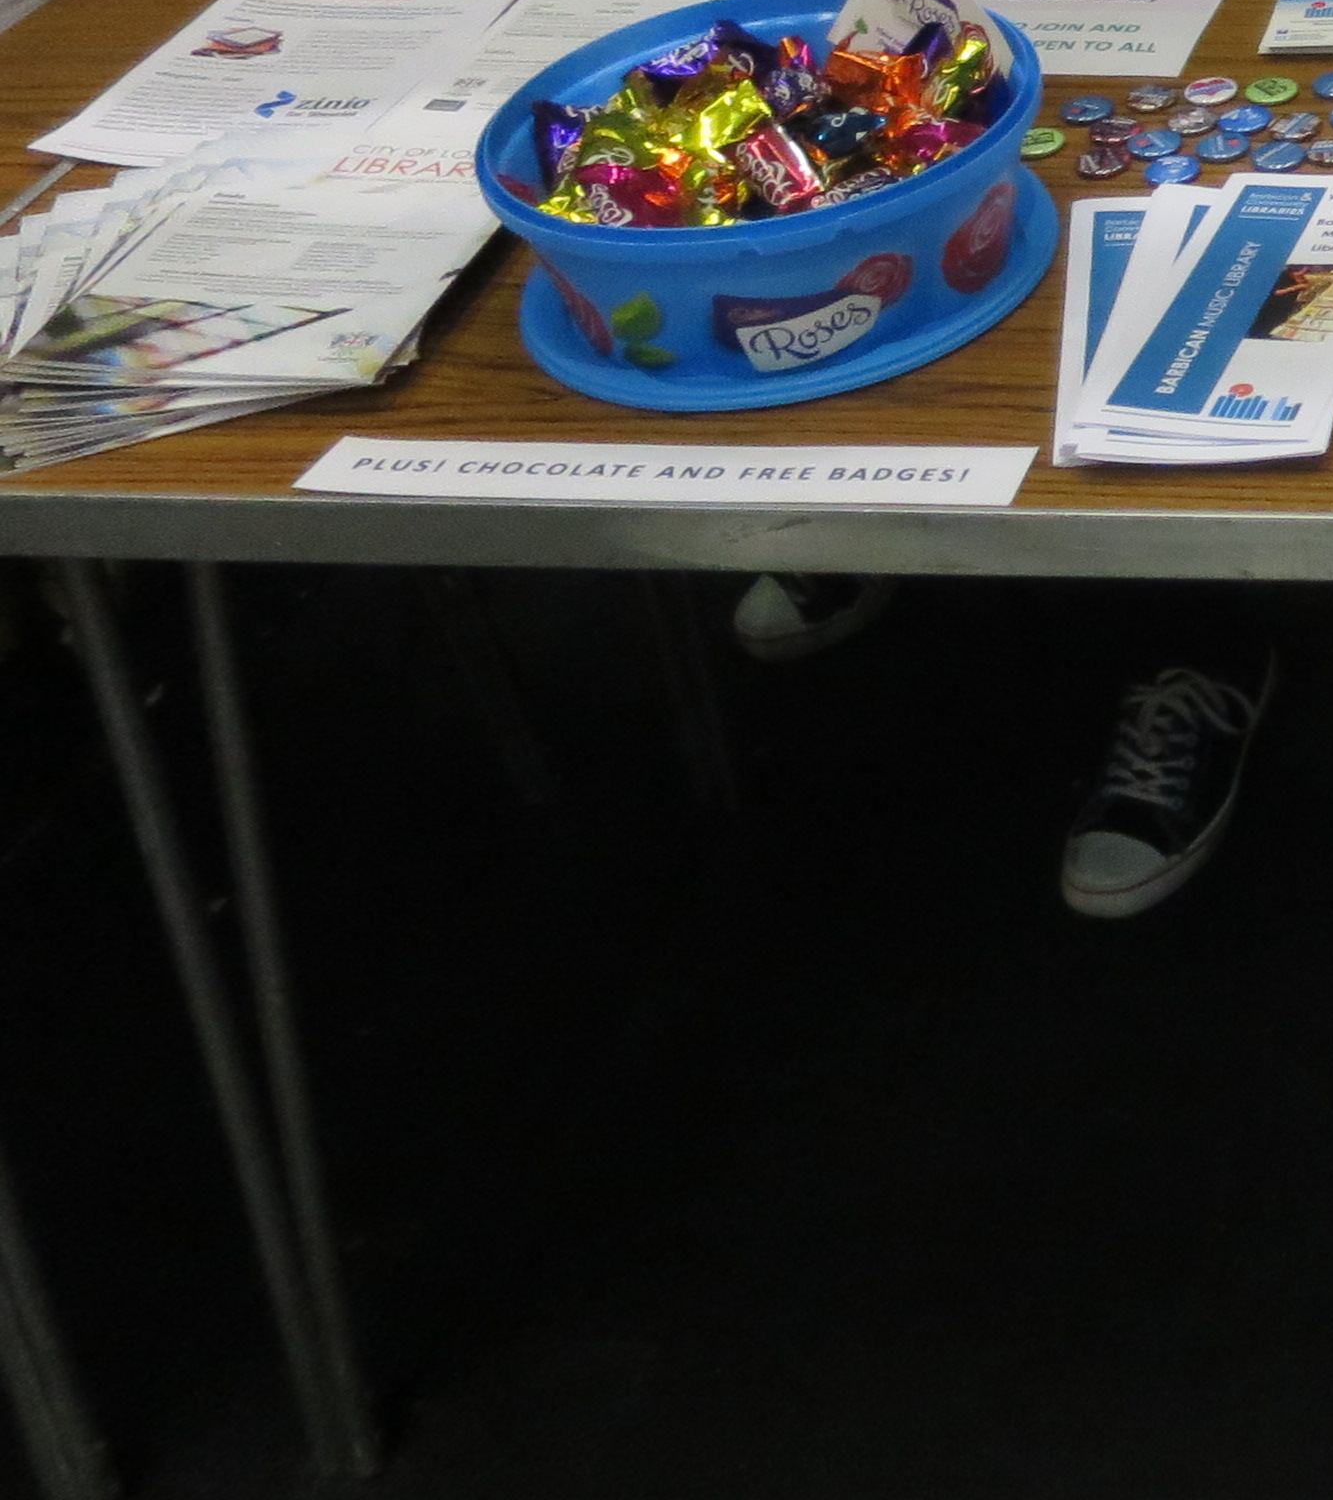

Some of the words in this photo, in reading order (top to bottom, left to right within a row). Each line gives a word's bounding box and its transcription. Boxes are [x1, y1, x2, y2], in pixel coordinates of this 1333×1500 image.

[294, 96, 372, 111] zinio
[749, 299, 872, 360] Roses
[352, 457, 446, 472] PLUS!
[457, 460, 645, 477] CHOCOLATE
[654, 465, 724, 481] AND
[743, 467, 814, 480] FREE
[827, 467, 969, 481] BADGES!
